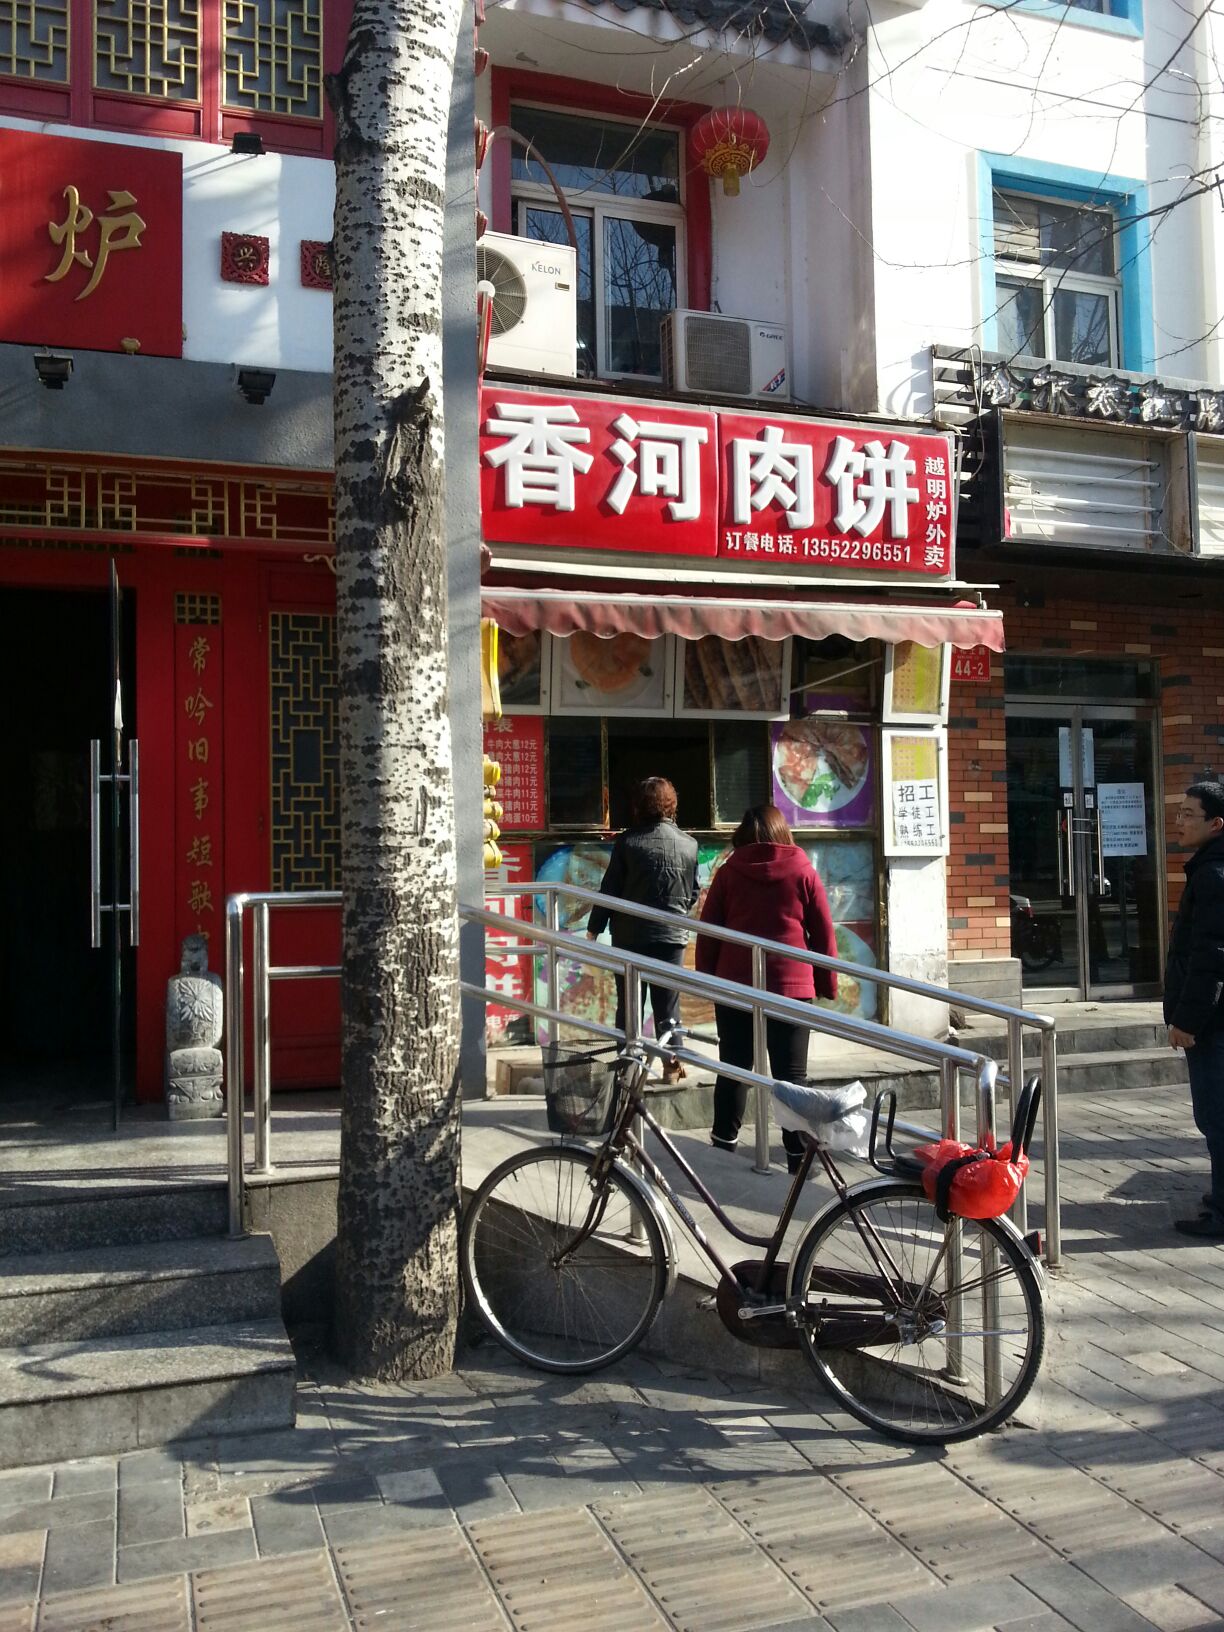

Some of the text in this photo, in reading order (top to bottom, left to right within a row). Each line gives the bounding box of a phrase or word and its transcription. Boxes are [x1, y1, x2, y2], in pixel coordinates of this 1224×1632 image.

[45, 184, 147, 302] 炉
[531, 261, 561, 275] KELON
[484, 402, 920, 540] 香河肉饼
[924, 456, 947, 568] 越明炉外卖
[955, 660, 984, 676] 44-2
[184, 636, 215, 938] 常吟旧事短歌
[897, 785, 935, 802] 招工
[898, 806, 935, 820] 学徒工
[900, 823, 936, 838] 熟练工
